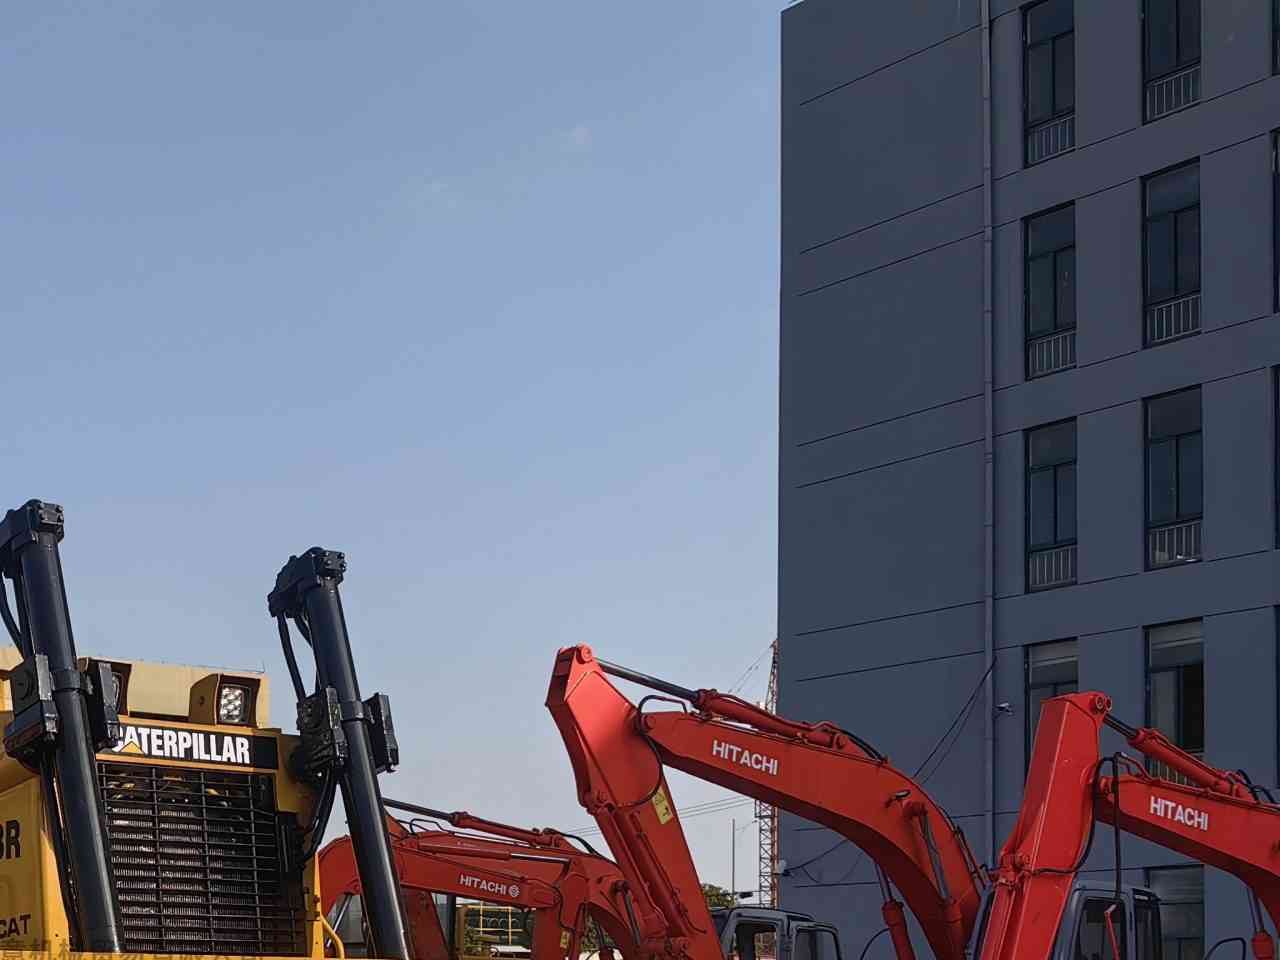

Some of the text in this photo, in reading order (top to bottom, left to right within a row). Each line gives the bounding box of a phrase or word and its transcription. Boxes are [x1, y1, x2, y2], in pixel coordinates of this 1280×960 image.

[712, 740, 778, 775] HITACHI
[1150, 796, 1209, 831] HITACHI
[459, 874, 507, 896] HITACHI
